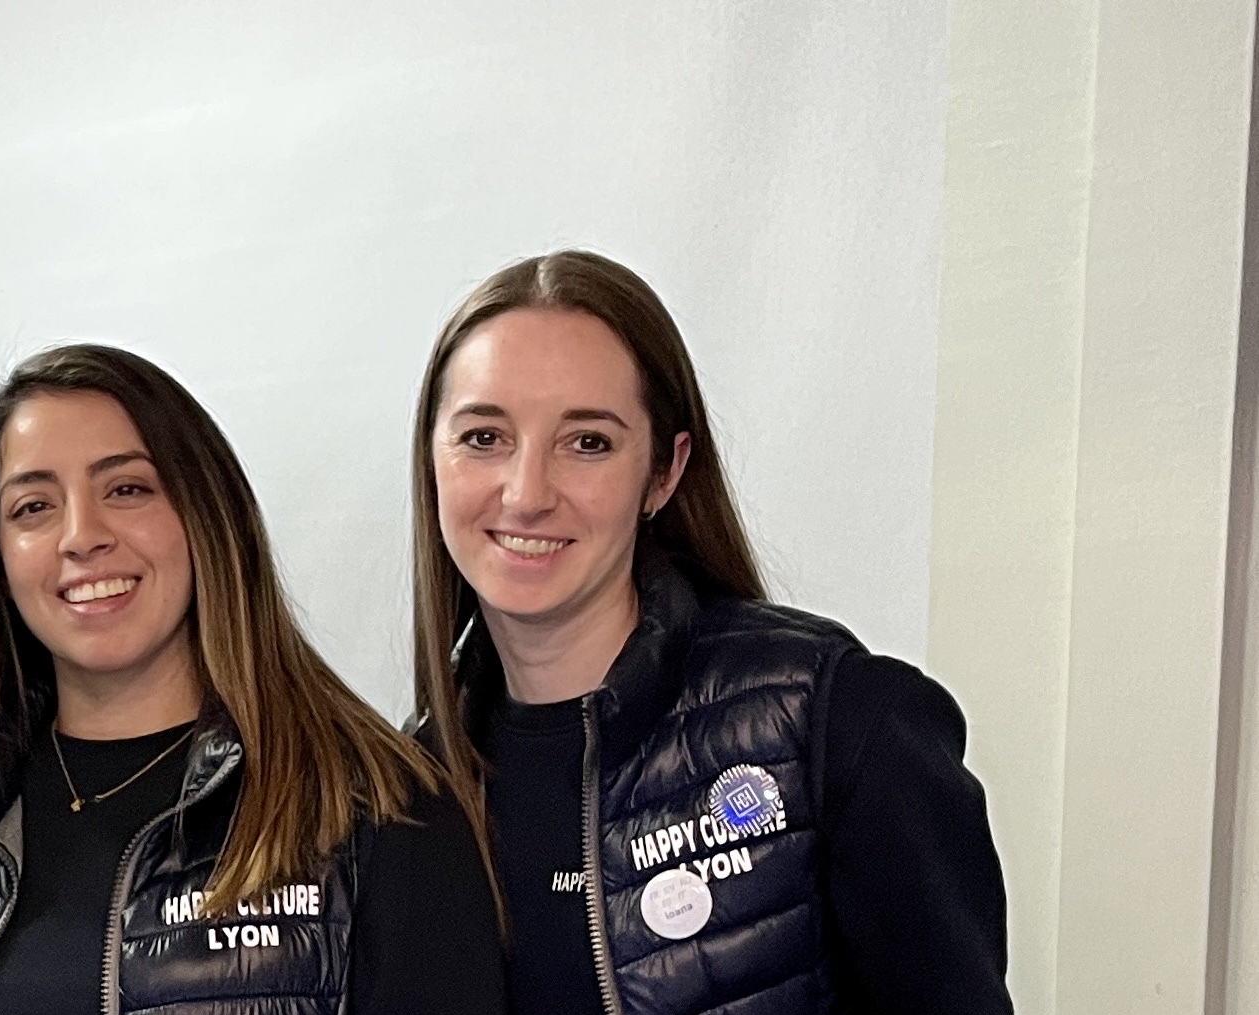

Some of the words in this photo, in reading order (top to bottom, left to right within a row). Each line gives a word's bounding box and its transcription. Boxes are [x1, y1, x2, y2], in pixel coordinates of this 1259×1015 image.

[631, 820, 696, 871] HAPPY
[679, 847, 753, 883] YON
[552, 871, 587, 892] HAPP
[208, 925, 280, 950] LYON
